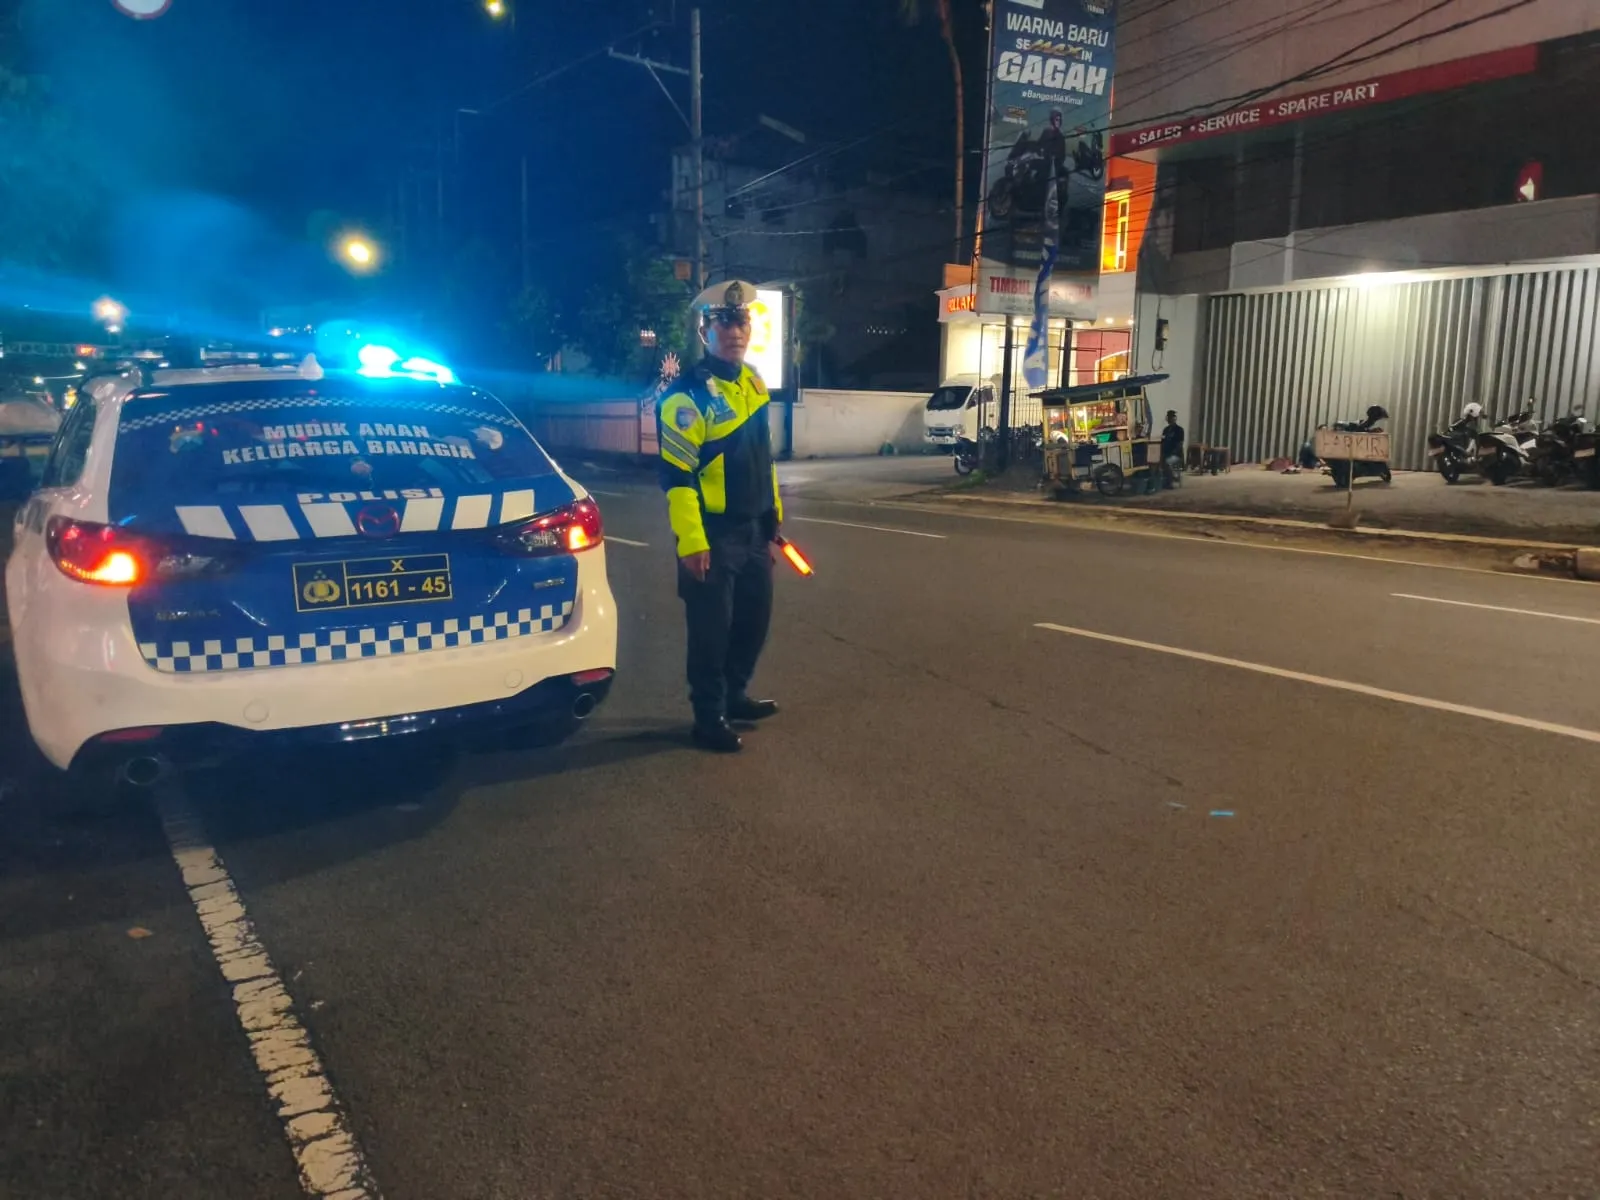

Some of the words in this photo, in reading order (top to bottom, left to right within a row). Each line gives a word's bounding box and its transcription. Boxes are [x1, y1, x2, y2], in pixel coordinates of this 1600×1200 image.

[1007, 12, 1064, 39] WARNA
[1067, 24, 1109, 47] BARU
[997, 51, 1107, 95] GAGAH
[1139, 125, 1182, 145] SALES
[1198, 108, 1260, 133] SERVICE
[1278, 92, 1330, 117] SPARE
[1333, 83, 1379, 106] PART
[263, 422, 349, 440] MUDIK
[359, 423, 429, 438] AMAN
[222, 440, 359, 465] KELUARGA
[366, 440, 476, 460] BAHAGIA
[297, 487, 444, 504] POLISI
[391, 559, 405, 572] X
[351, 579, 399, 600] 1161
[421, 576, 446, 594] 45
